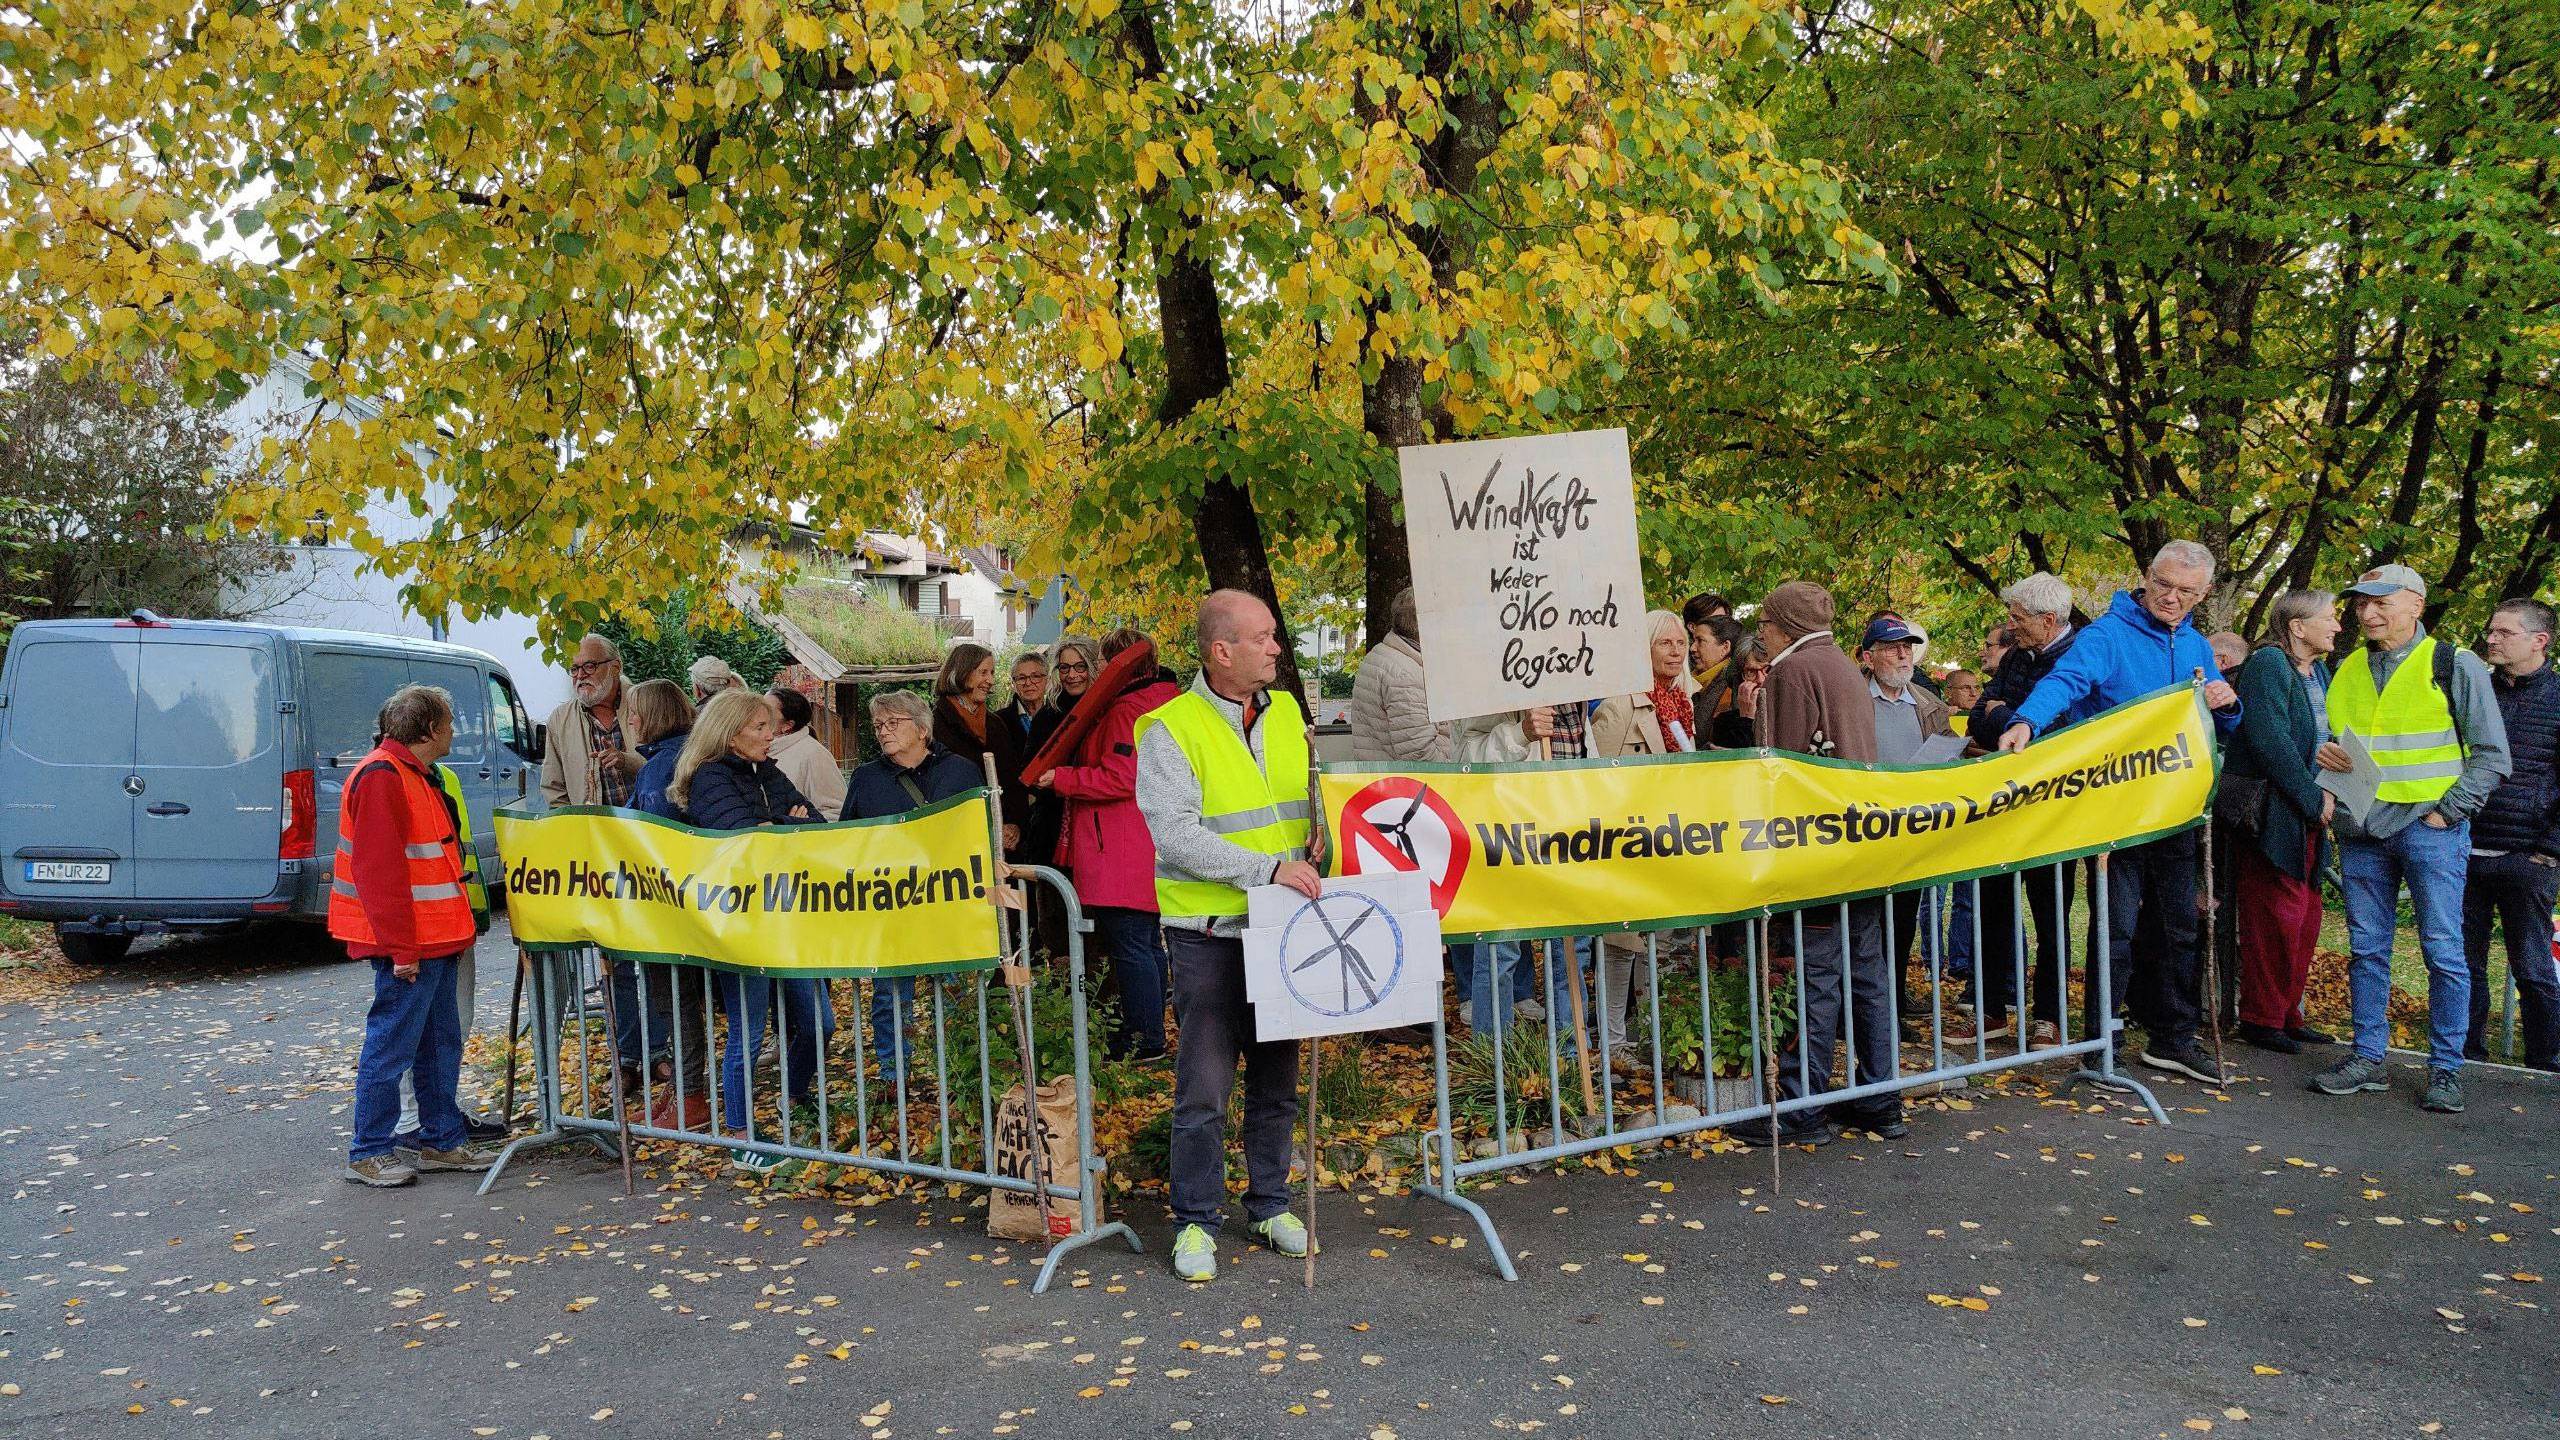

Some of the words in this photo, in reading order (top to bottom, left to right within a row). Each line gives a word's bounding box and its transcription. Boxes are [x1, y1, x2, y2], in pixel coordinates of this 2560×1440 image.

[1512, 531, 1540, 561] ist
[1568, 583, 1619, 628] noch
[1501, 631, 1594, 688] logisch
[1475, 813, 1729, 867] Windräder
[1738, 801, 1956, 852] zerstören
[1958, 732, 2194, 824] Lebensräume!
[85, 866, 103, 879] 22
[510, 856, 561, 896] den
[567, 860, 697, 910] Hochbühl
[697, 881, 757, 915] vor
[763, 854, 986, 913] Windrädern!
